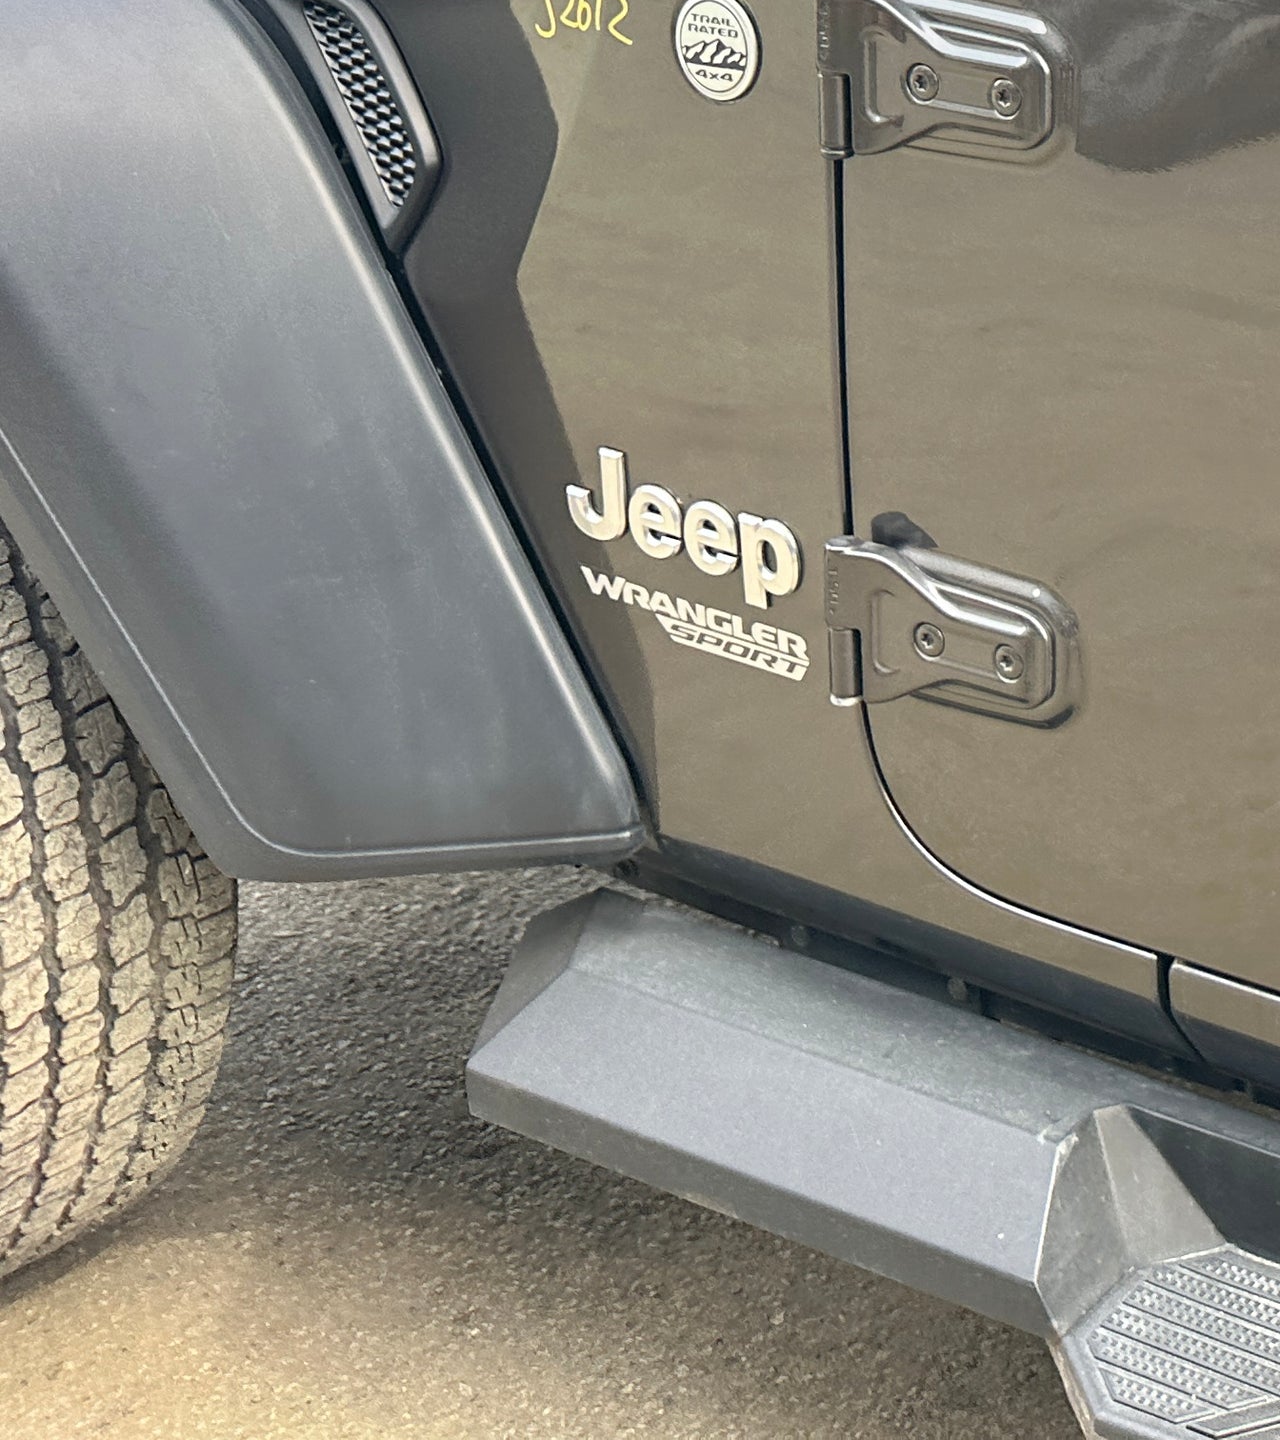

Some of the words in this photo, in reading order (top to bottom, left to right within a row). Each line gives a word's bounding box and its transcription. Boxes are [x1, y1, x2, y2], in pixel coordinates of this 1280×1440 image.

[687, 22, 740, 40] RATED
[689, 12, 736, 29] TRAIL
[565, 446, 801, 610] Jeep
[580, 565, 810, 658] WRANGLER
[667, 622, 800, 675] SPORT
